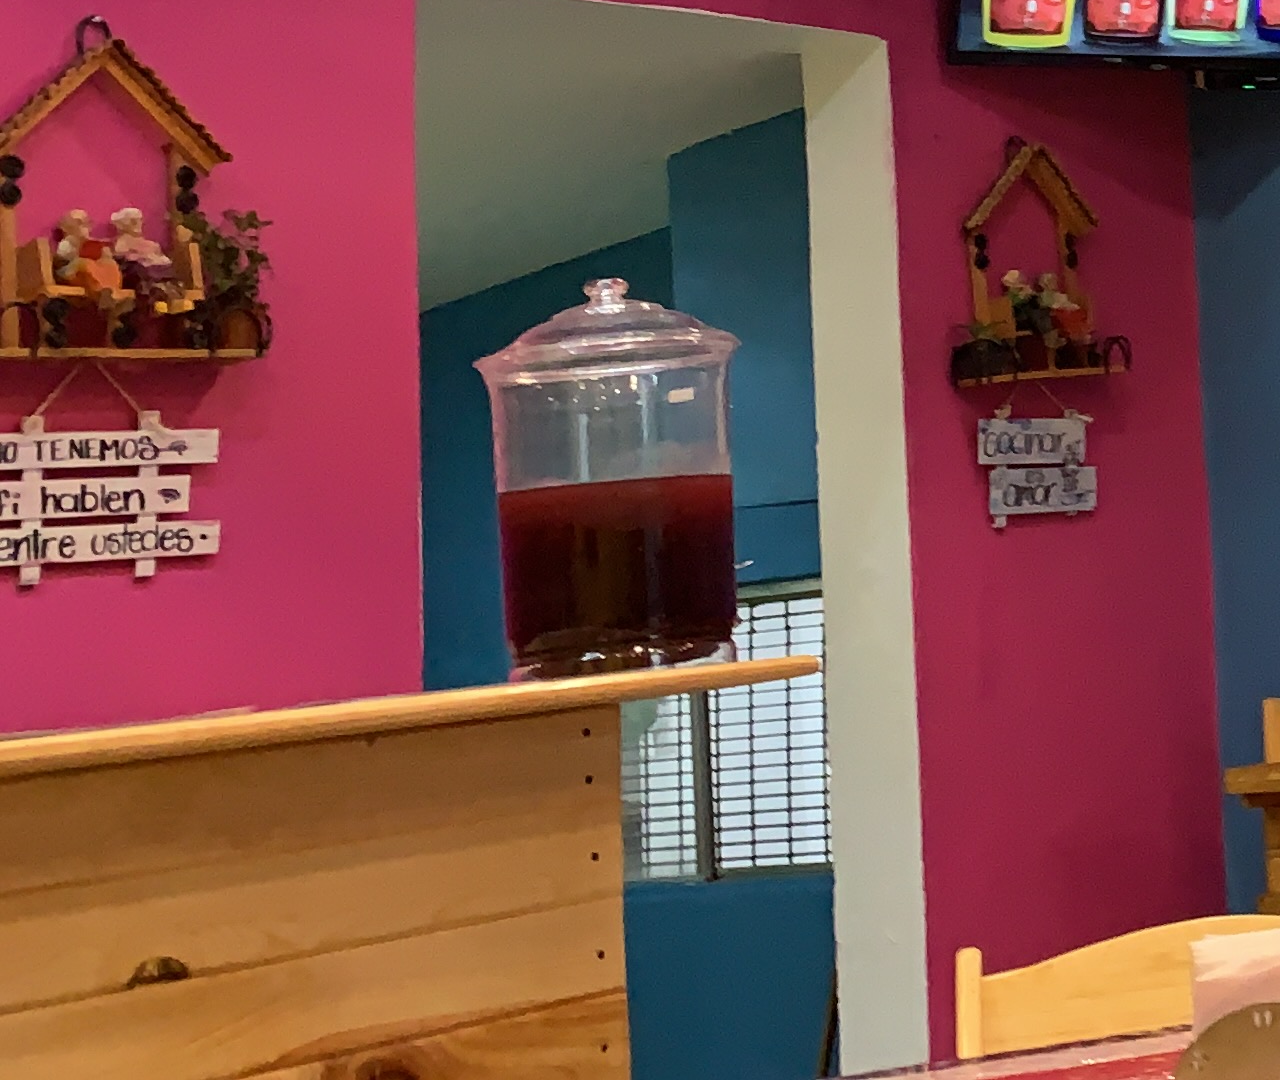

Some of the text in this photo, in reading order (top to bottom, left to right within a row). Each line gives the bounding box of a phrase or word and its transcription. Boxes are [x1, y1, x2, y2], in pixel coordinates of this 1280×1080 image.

[34, 436, 160, 462] TENEMOS
[41, 484, 146, 514] hablen
[0, 529, 76, 561] entre
